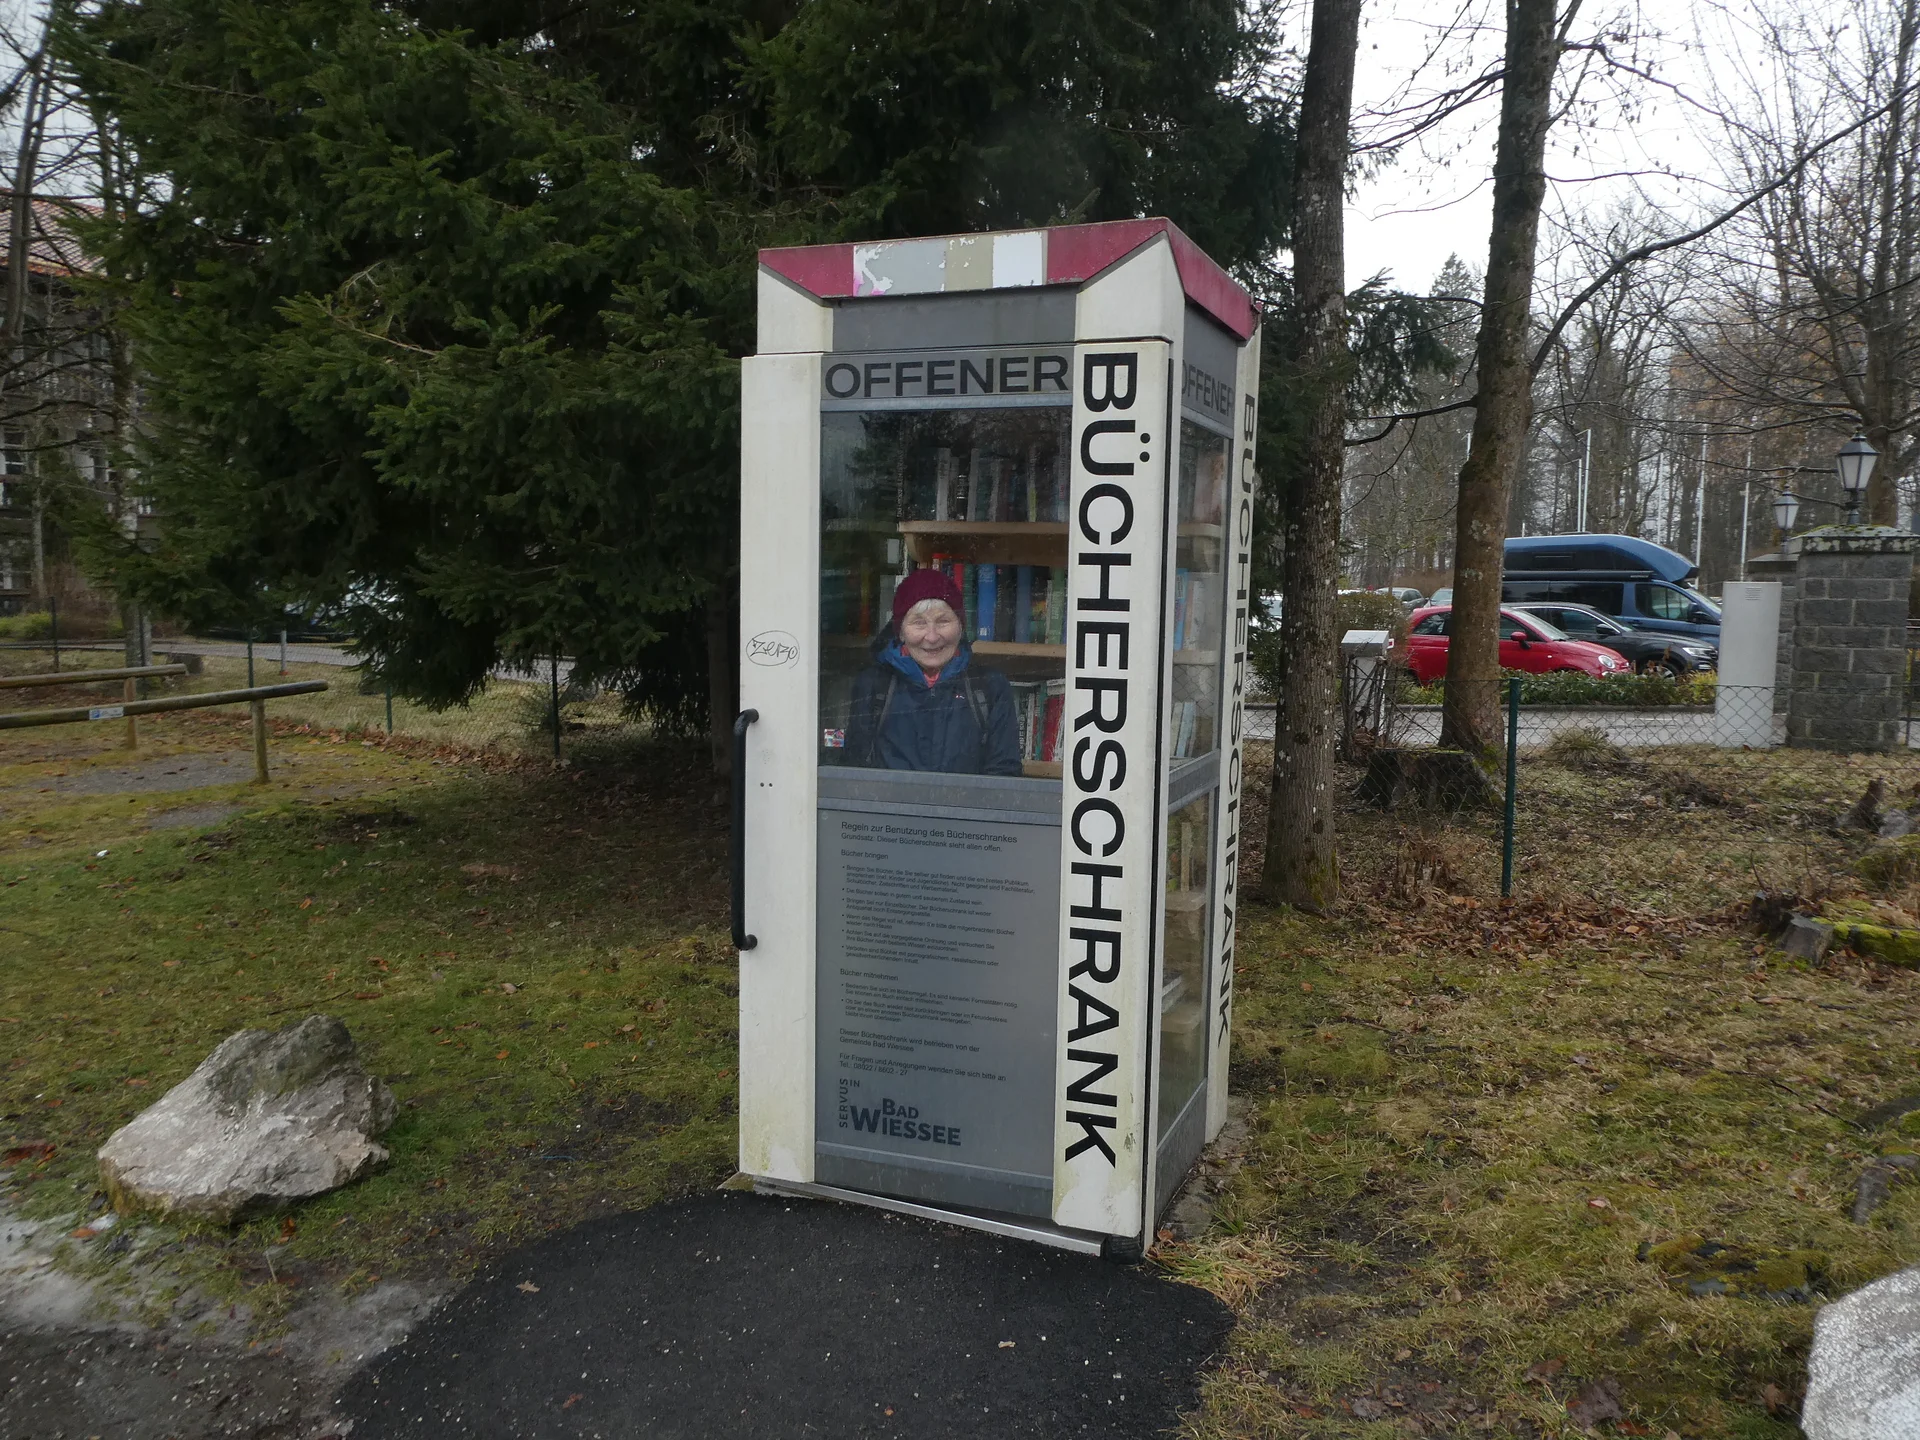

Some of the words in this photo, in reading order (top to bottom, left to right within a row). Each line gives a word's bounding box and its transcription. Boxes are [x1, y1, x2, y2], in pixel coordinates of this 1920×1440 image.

[825, 355, 1068, 398] OFFENER
[1065, 352, 1150, 1168] BÜCHERSCHRANK
[841, 820, 868, 833] Regeln
[885, 824, 927, 838] Benutzung
[929, 827, 944, 837] des
[946, 829, 1018, 843] Bücherschrankes
[839, 1078, 849, 1128] SERVUS
[850, 1079, 860, 1088] IN
[850, 1105, 961, 1146] WIESSEE
